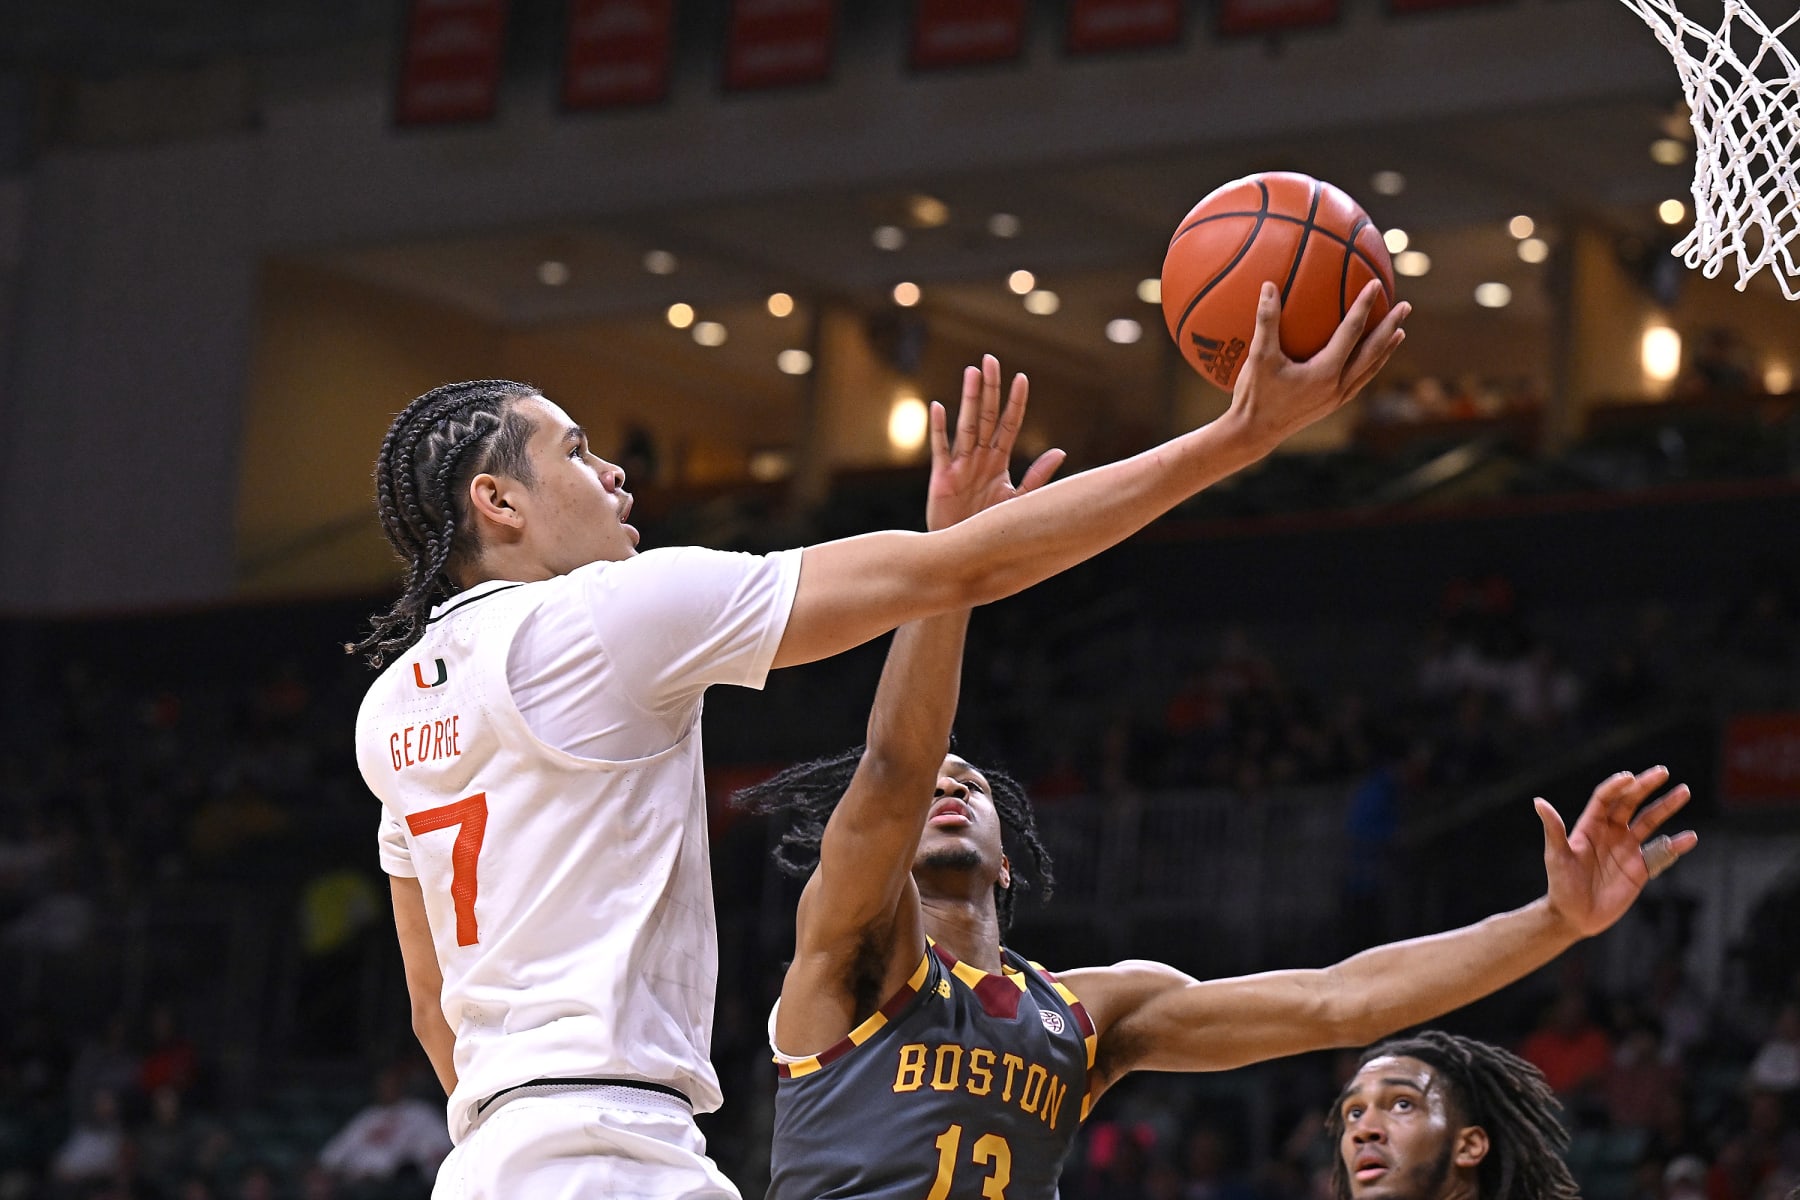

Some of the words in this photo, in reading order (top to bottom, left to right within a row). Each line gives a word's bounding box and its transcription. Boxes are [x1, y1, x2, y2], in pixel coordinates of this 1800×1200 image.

[412, 658, 448, 689] U
[390, 715, 462, 772] GEORGE
[404, 791, 489, 948] 7
[892, 1042, 1068, 1131] BOSTON
[926, 1123, 1013, 1200] 13
